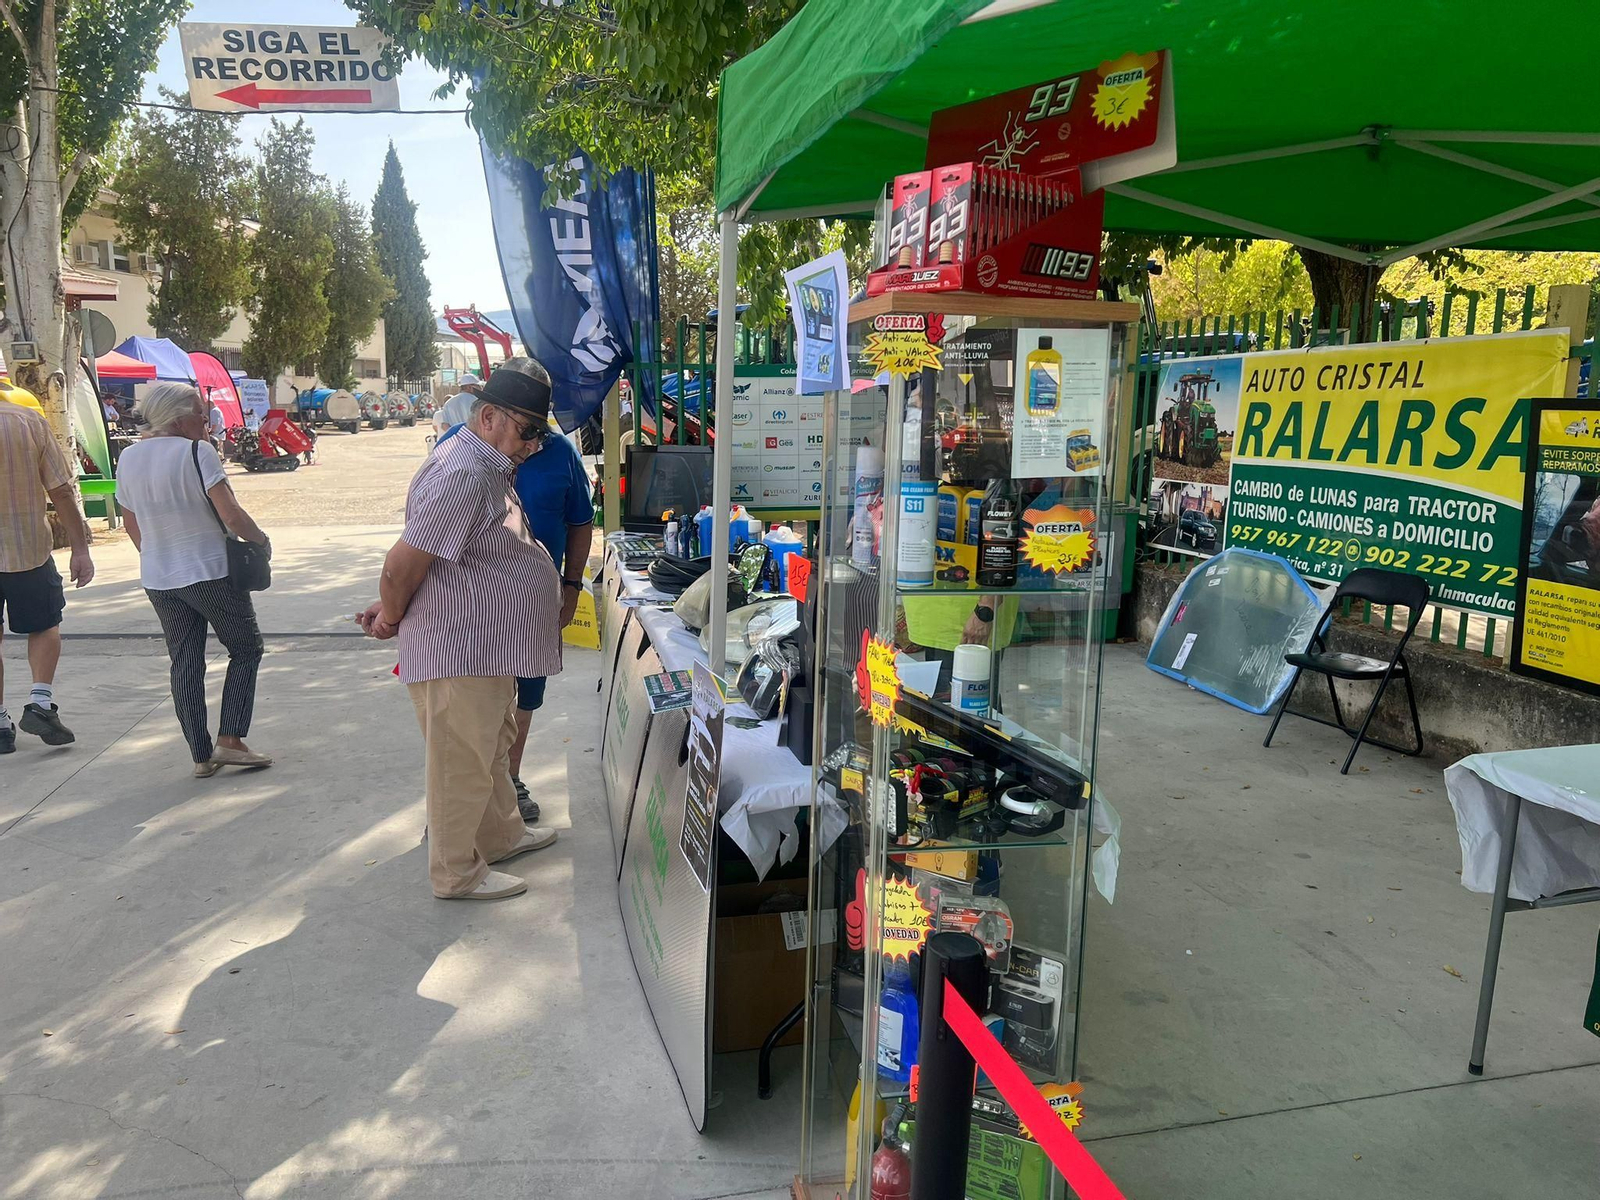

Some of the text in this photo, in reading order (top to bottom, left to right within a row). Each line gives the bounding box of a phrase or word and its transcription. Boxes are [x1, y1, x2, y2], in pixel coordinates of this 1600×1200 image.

[222, 29, 361, 56] SIGA EL
[192, 56, 395, 82] RECORRIDO
[1105, 69, 1143, 86] OFERTA
[1025, 76, 1080, 122] 93
[1103, 97, 1129, 116] 3€
[889, 206, 927, 258] 93
[928, 198, 969, 254] 93
[885, 283, 917, 293] AMBIENTADOR
[876, 315, 925, 329] OFERTA
[943, 342, 992, 350] TRATAMIENTO
[944, 352, 989, 360] ANTI-LLUVIA
[1246, 360, 1426, 393] AUTO CRISTAL
[808, 435, 823, 444] HD
[1237, 397, 1530, 473] RALARSA
[779, 439, 794, 447] Ges
[1543, 449, 1570, 460] EVITE
[901, 464, 920, 473] LOW
[1543, 459, 1600, 473] REPARAMOS
[906, 499, 923, 511] S11
[1234, 479, 1497, 524] CAMBIO de LUNAS para TRACTOR
[1037, 523, 1081, 534] OFERTA
[1232, 501, 1288, 524] TURISMO
[1297, 509, 1374, 536] CAMIONES
[1377, 523, 1388, 538] a
[1392, 521, 1494, 553] DOMICILIO
[1231, 524, 1519, 587] 957 967 122 902 222 72
[1328, 563, 1344, 578] 31
[1530, 588, 1564, 601] RALARSA
[1567, 596, 1588, 605] repara
[1541, 601, 1572, 613] recambios
[1528, 608, 1549, 618] calidad
[1588, 622, 1600, 630] seg
[1534, 618, 1570, 633] Reglamento
[1526, 628, 1567, 643] UE 461/2010
[909, 914, 928, 927] 10€
[1009, 962, 1040, 977] N-CAR
[1047, 1095, 1070, 1107] RTA
